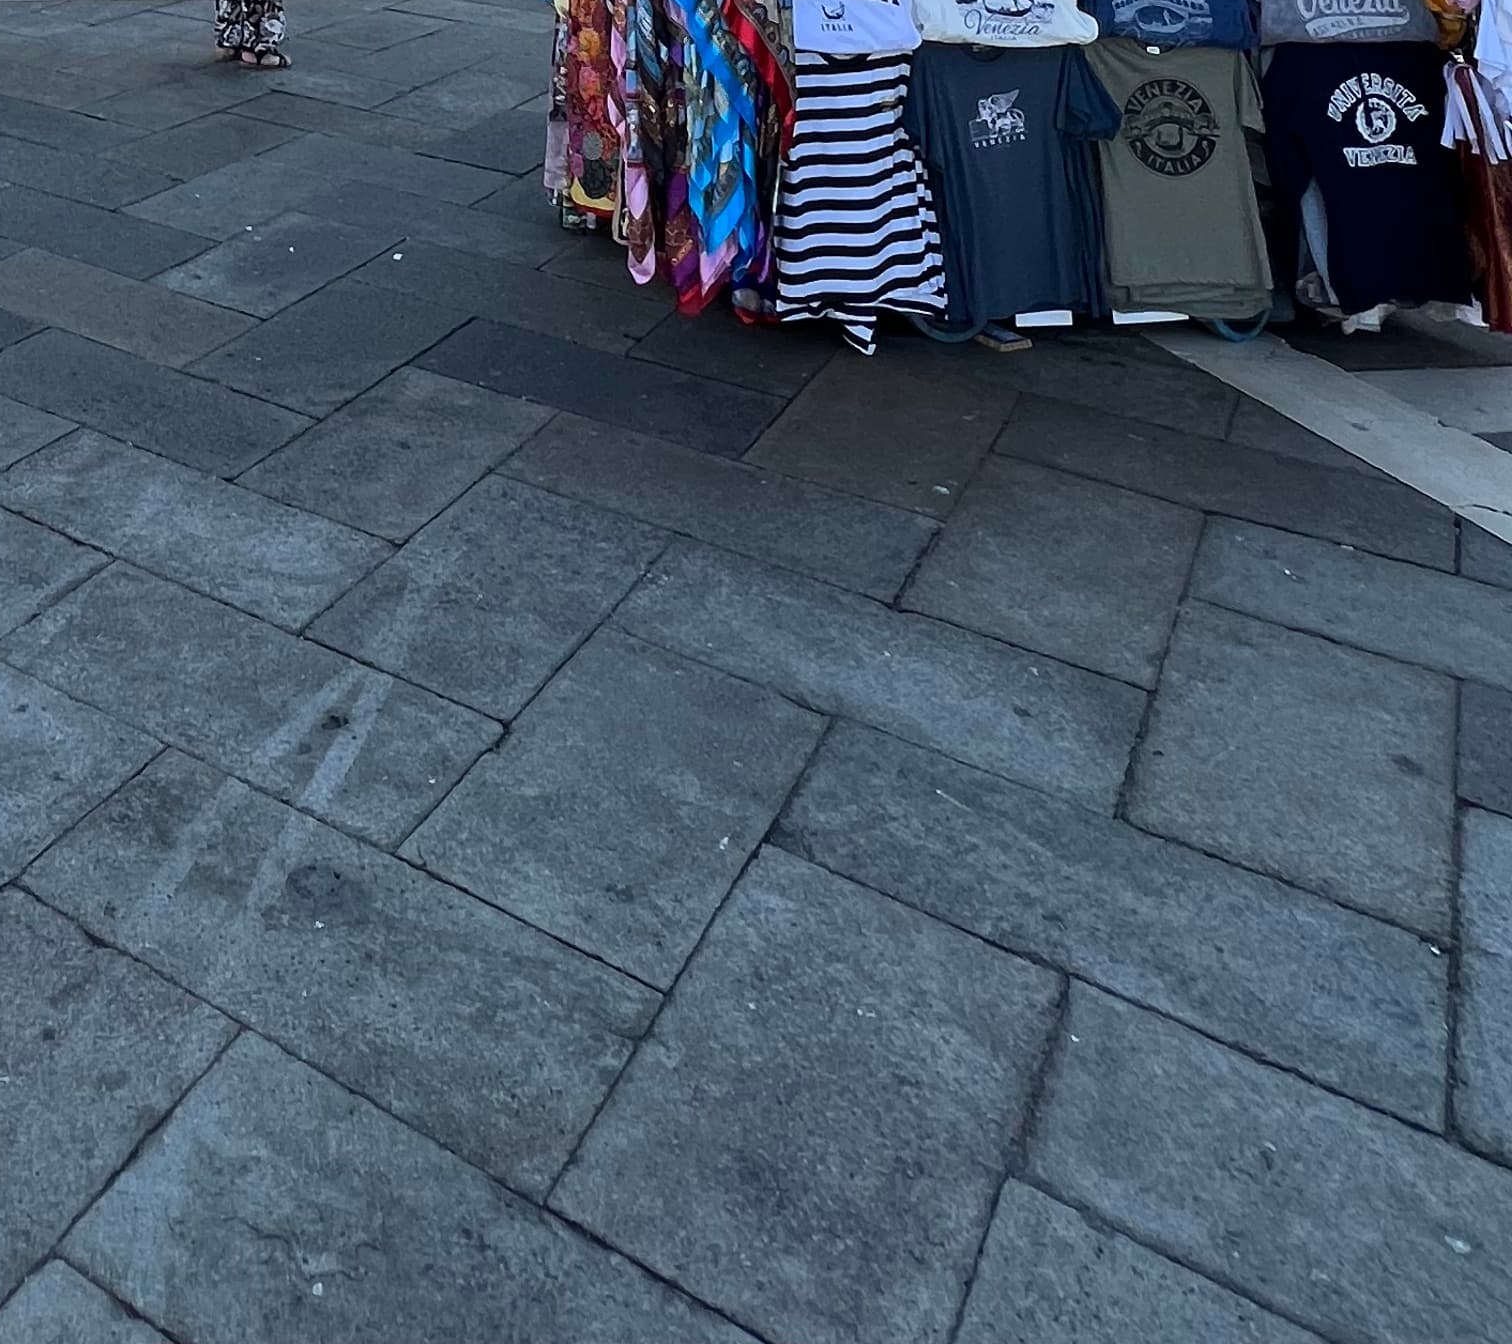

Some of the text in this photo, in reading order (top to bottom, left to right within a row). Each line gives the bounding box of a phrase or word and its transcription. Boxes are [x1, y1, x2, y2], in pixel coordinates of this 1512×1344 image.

[821, 23, 854, 33] ITALIA
[964, 9, 1040, 35] Venezia
[1128, 81, 1203, 113] VENEZIA
[1148, 154, 1202, 173] ITALIA
[1342, 144, 1418, 167] VENEZIA
